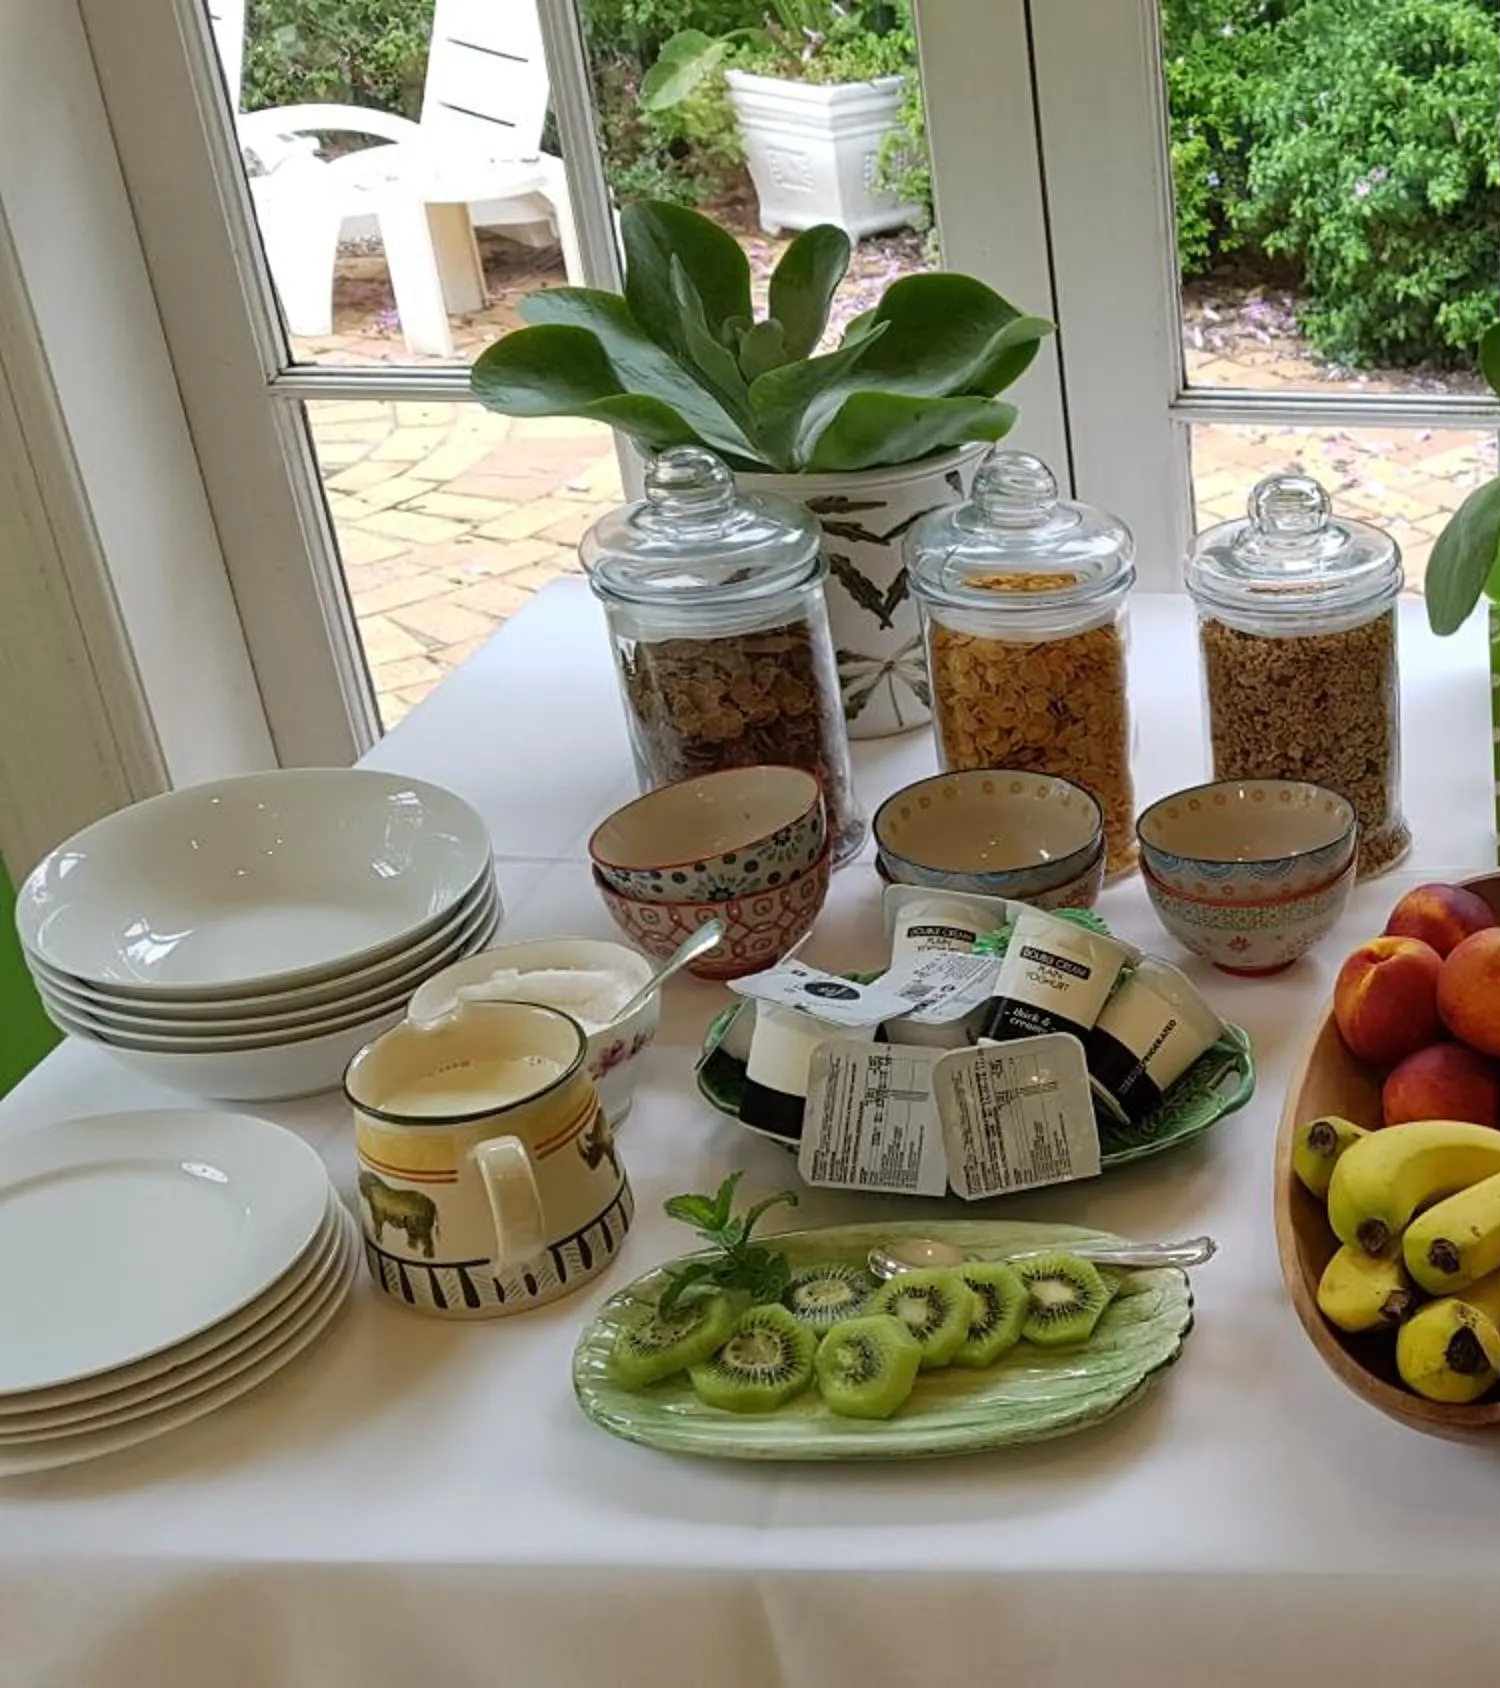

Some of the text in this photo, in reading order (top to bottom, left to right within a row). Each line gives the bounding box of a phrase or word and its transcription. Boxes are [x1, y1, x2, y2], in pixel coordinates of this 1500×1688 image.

[1022, 947, 1089, 979] DOUBLE CREAM
[1012, 1007, 1040, 1023] thick
